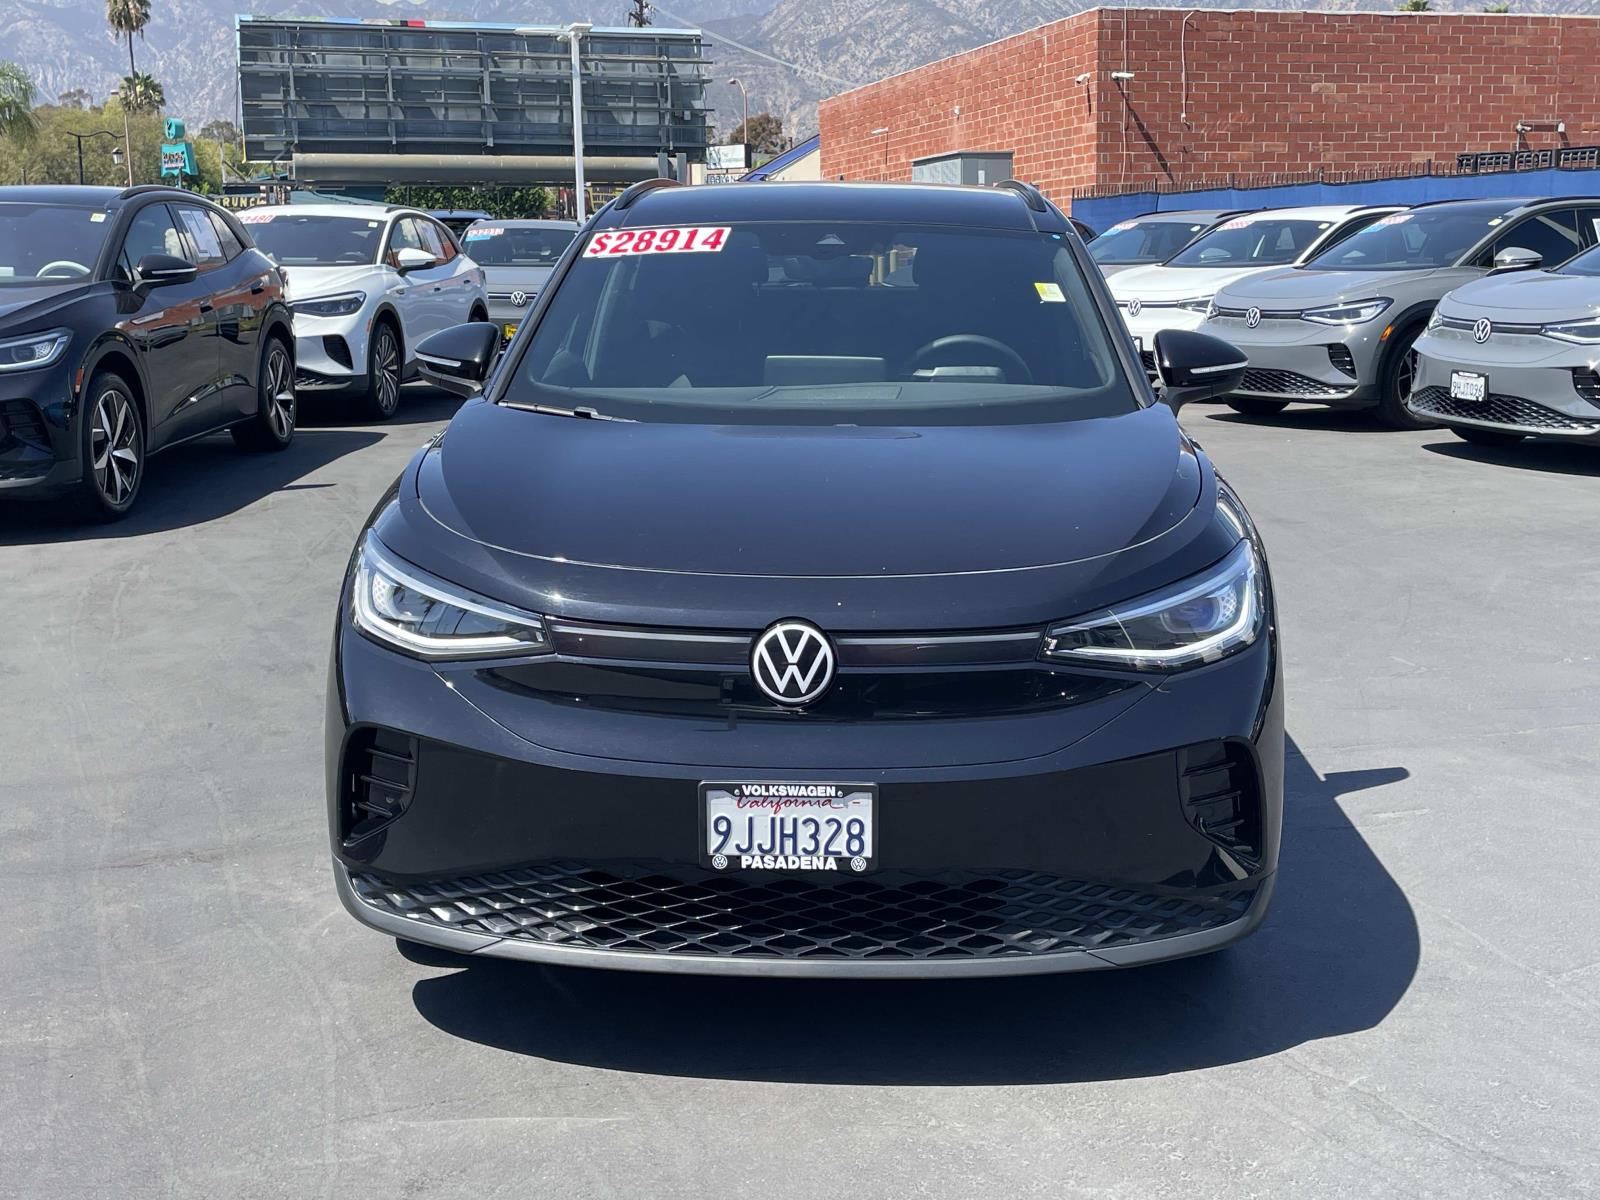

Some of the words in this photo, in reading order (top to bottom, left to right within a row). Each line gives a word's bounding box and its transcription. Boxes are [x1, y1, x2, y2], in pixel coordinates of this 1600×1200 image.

[590, 229, 724, 255] $28914
[756, 626, 831, 699] VW
[741, 785, 836, 797] VOLKSWAGEN
[736, 796, 844, 815] California
[713, 815, 865, 856] 9JJH328
[741, 855, 837, 870] PASADENA
